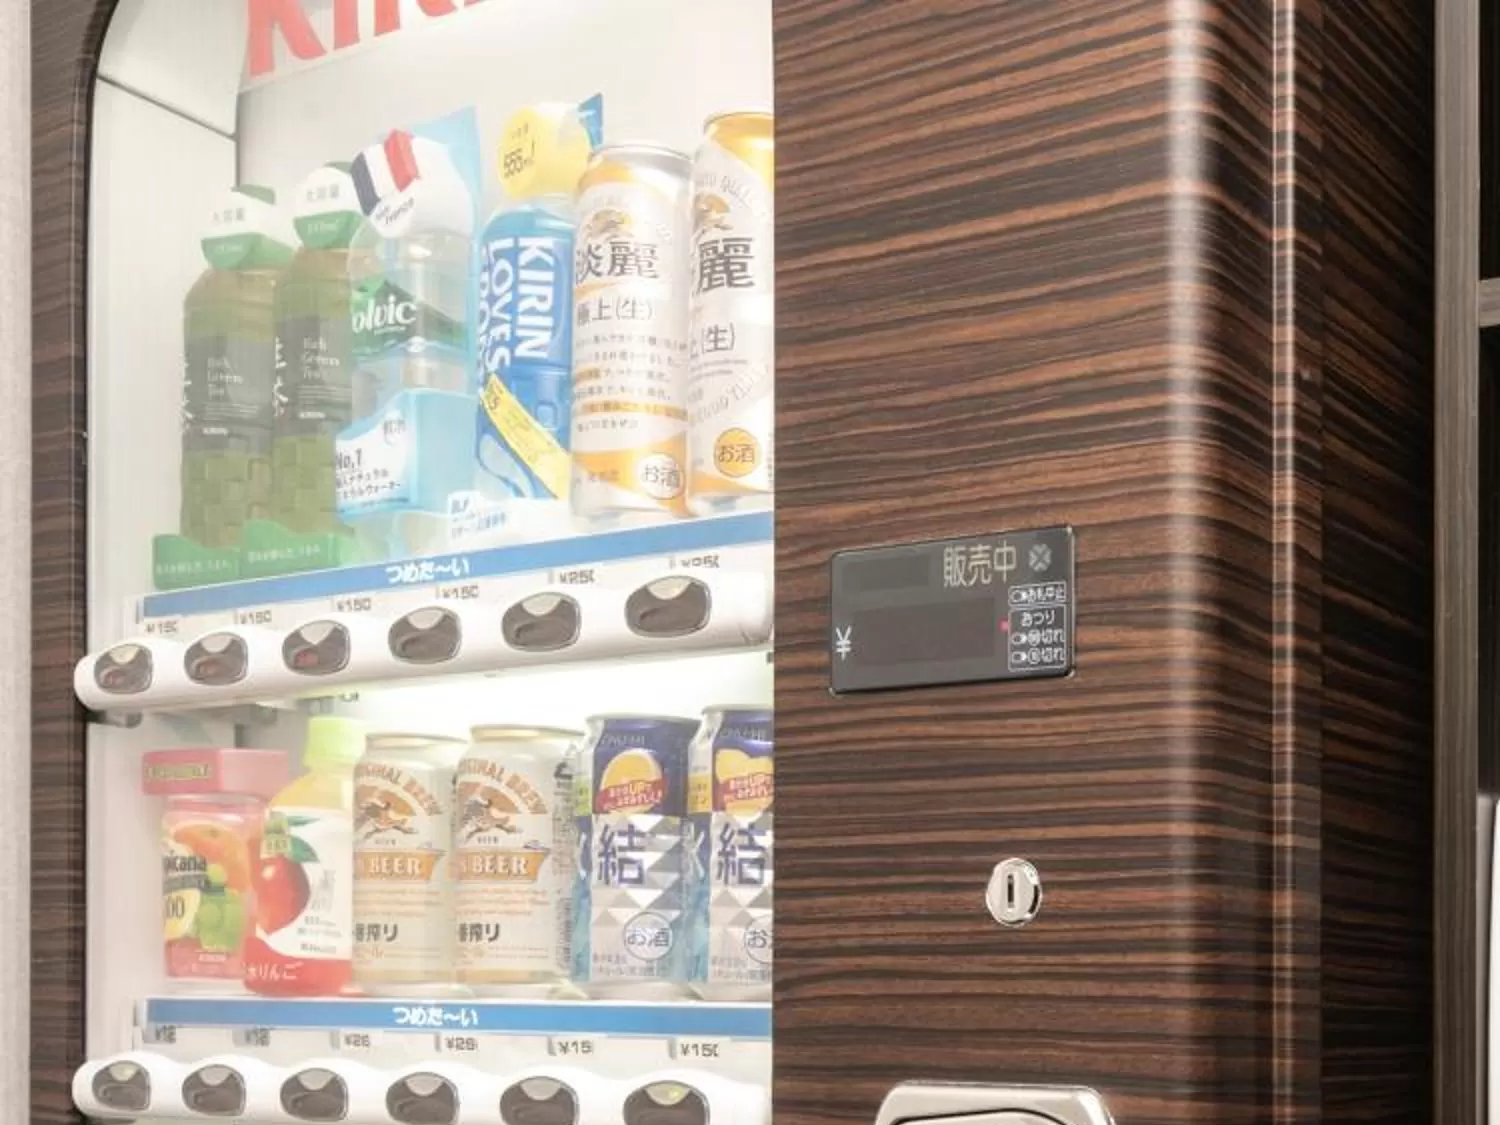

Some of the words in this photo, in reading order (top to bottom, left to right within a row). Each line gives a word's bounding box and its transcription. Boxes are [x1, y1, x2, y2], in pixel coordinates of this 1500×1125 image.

[691, 236, 756, 294] 麗
[351, 294, 418, 334] olvic
[485, 237, 514, 371] LOVES
[514, 237, 555, 358] KIRIN
[943, 540, 1017, 587] 販売中
[370, 856, 422, 875] BEER
[472, 854, 529, 875] BEER
[598, 823, 646, 885] 結
[715, 822, 767, 885] 結
[558, 1040, 594, 1055] ¥15
